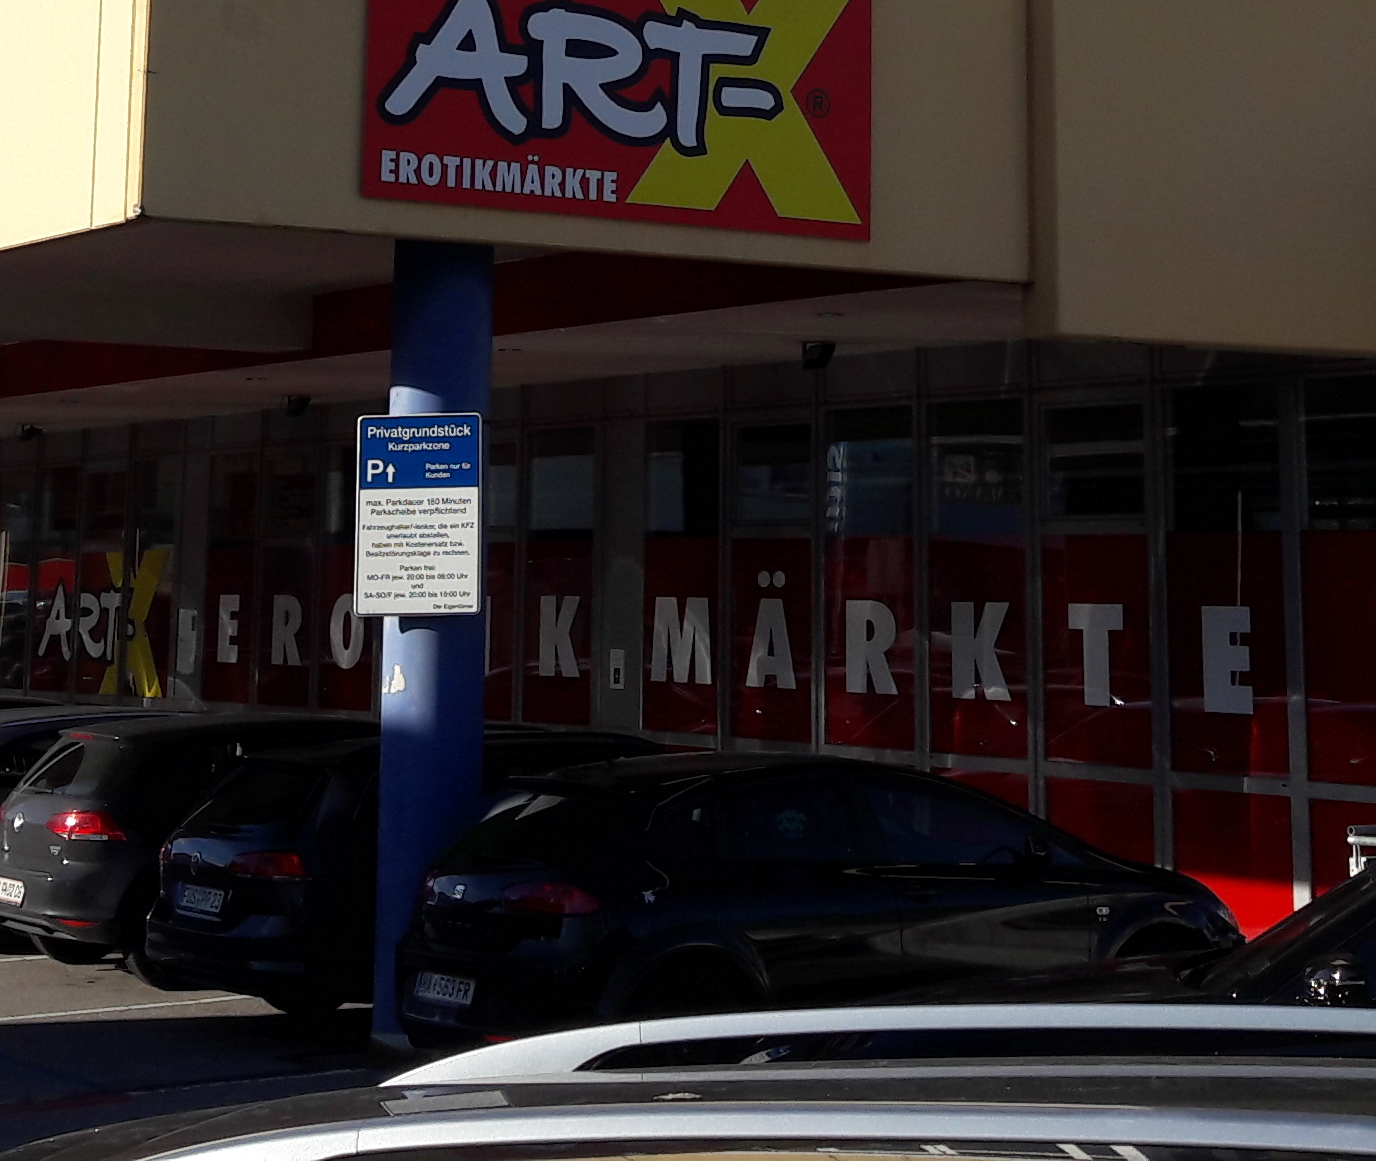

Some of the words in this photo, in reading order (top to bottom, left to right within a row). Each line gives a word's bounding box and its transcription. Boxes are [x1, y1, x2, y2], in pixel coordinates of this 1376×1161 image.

[379, 149, 619, 203] EROTIKMÄRKTE
[367, 423, 472, 440] Privatgrundstück
[388, 442, 451, 453] Kurzparkzone
[425, 462, 448, 470] Parken
[385, 497, 424, 506] Parkdauer
[442, 497, 472, 505] Minuten
[370, 508, 416, 516] Parkscheibe
[417, 506, 467, 516] verpflichtend
[460, 521, 475, 529] KFZ
[405, 540, 449, 548] Kostenersatz
[456, 572, 469, 580] Uhr
[427, 590, 438, 598] bis
